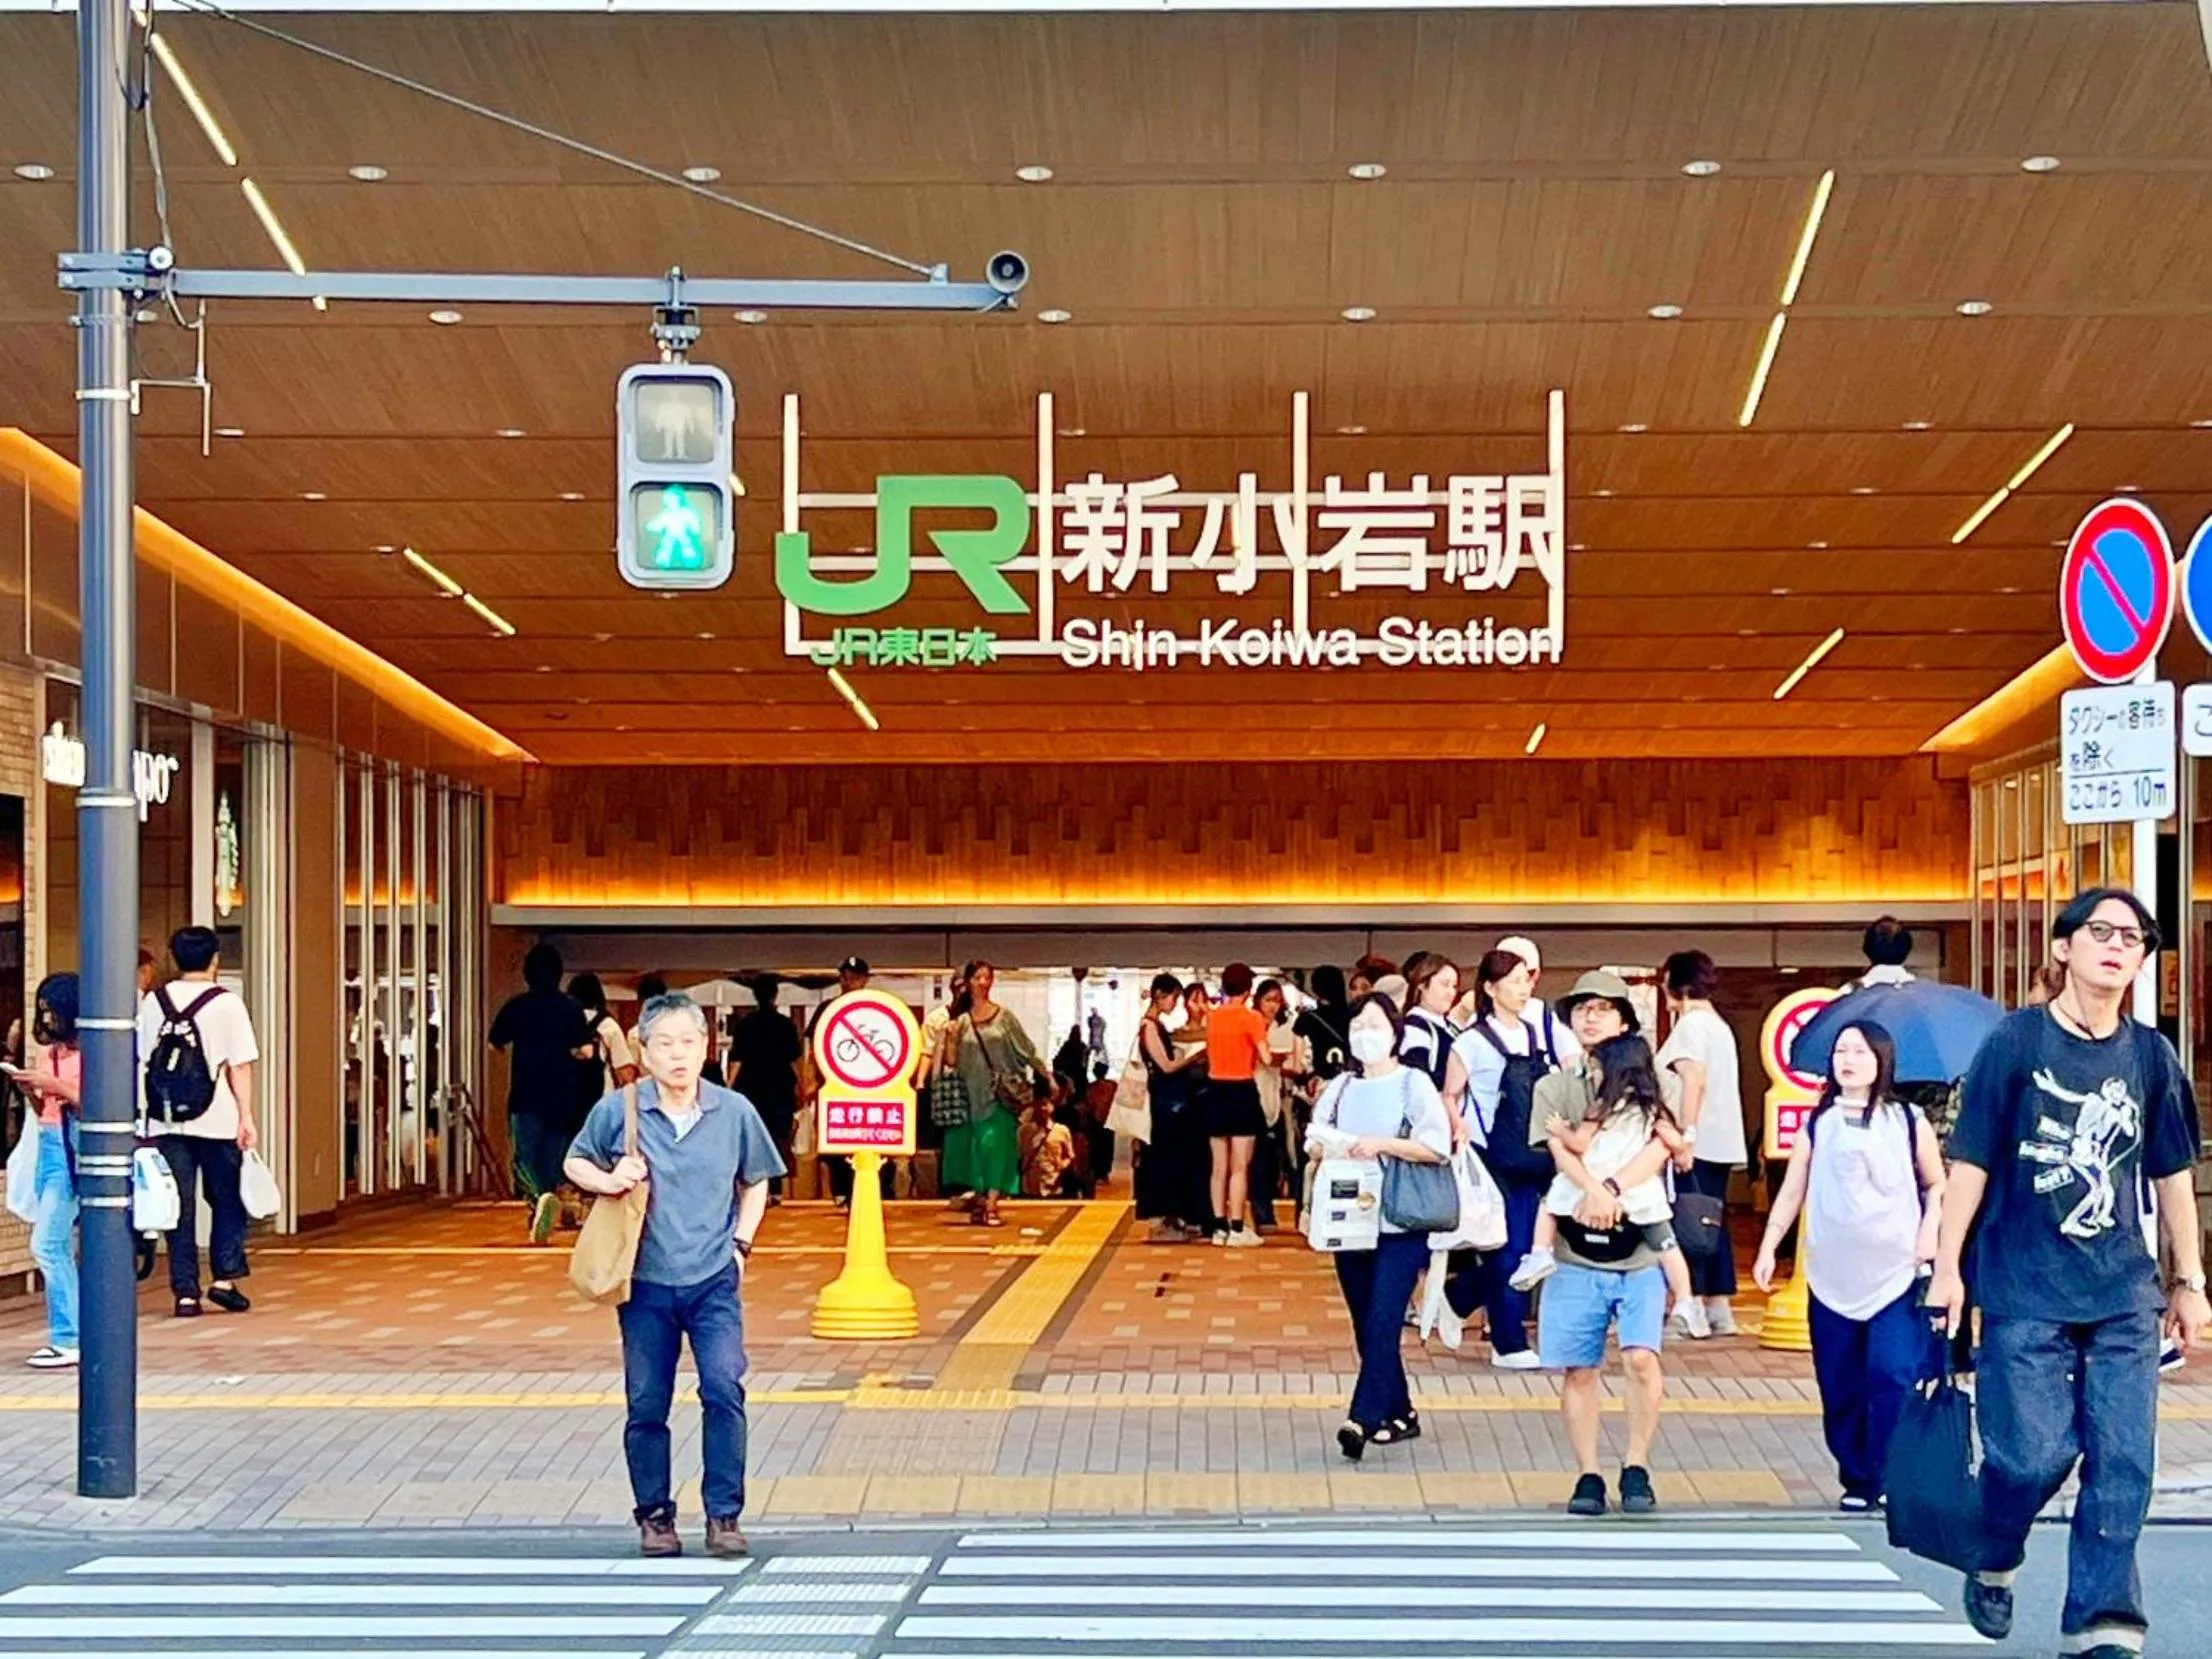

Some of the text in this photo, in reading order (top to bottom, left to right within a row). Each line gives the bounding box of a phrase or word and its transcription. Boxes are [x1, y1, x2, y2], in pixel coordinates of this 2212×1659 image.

[774, 475, 1031, 614] JR
[1060, 472, 1559, 595] 新小岩駅
[810, 626, 998, 667] JR東日本
[1379, 615, 1561, 667] Station
[2069, 775, 2167, 811] ここから 10m
